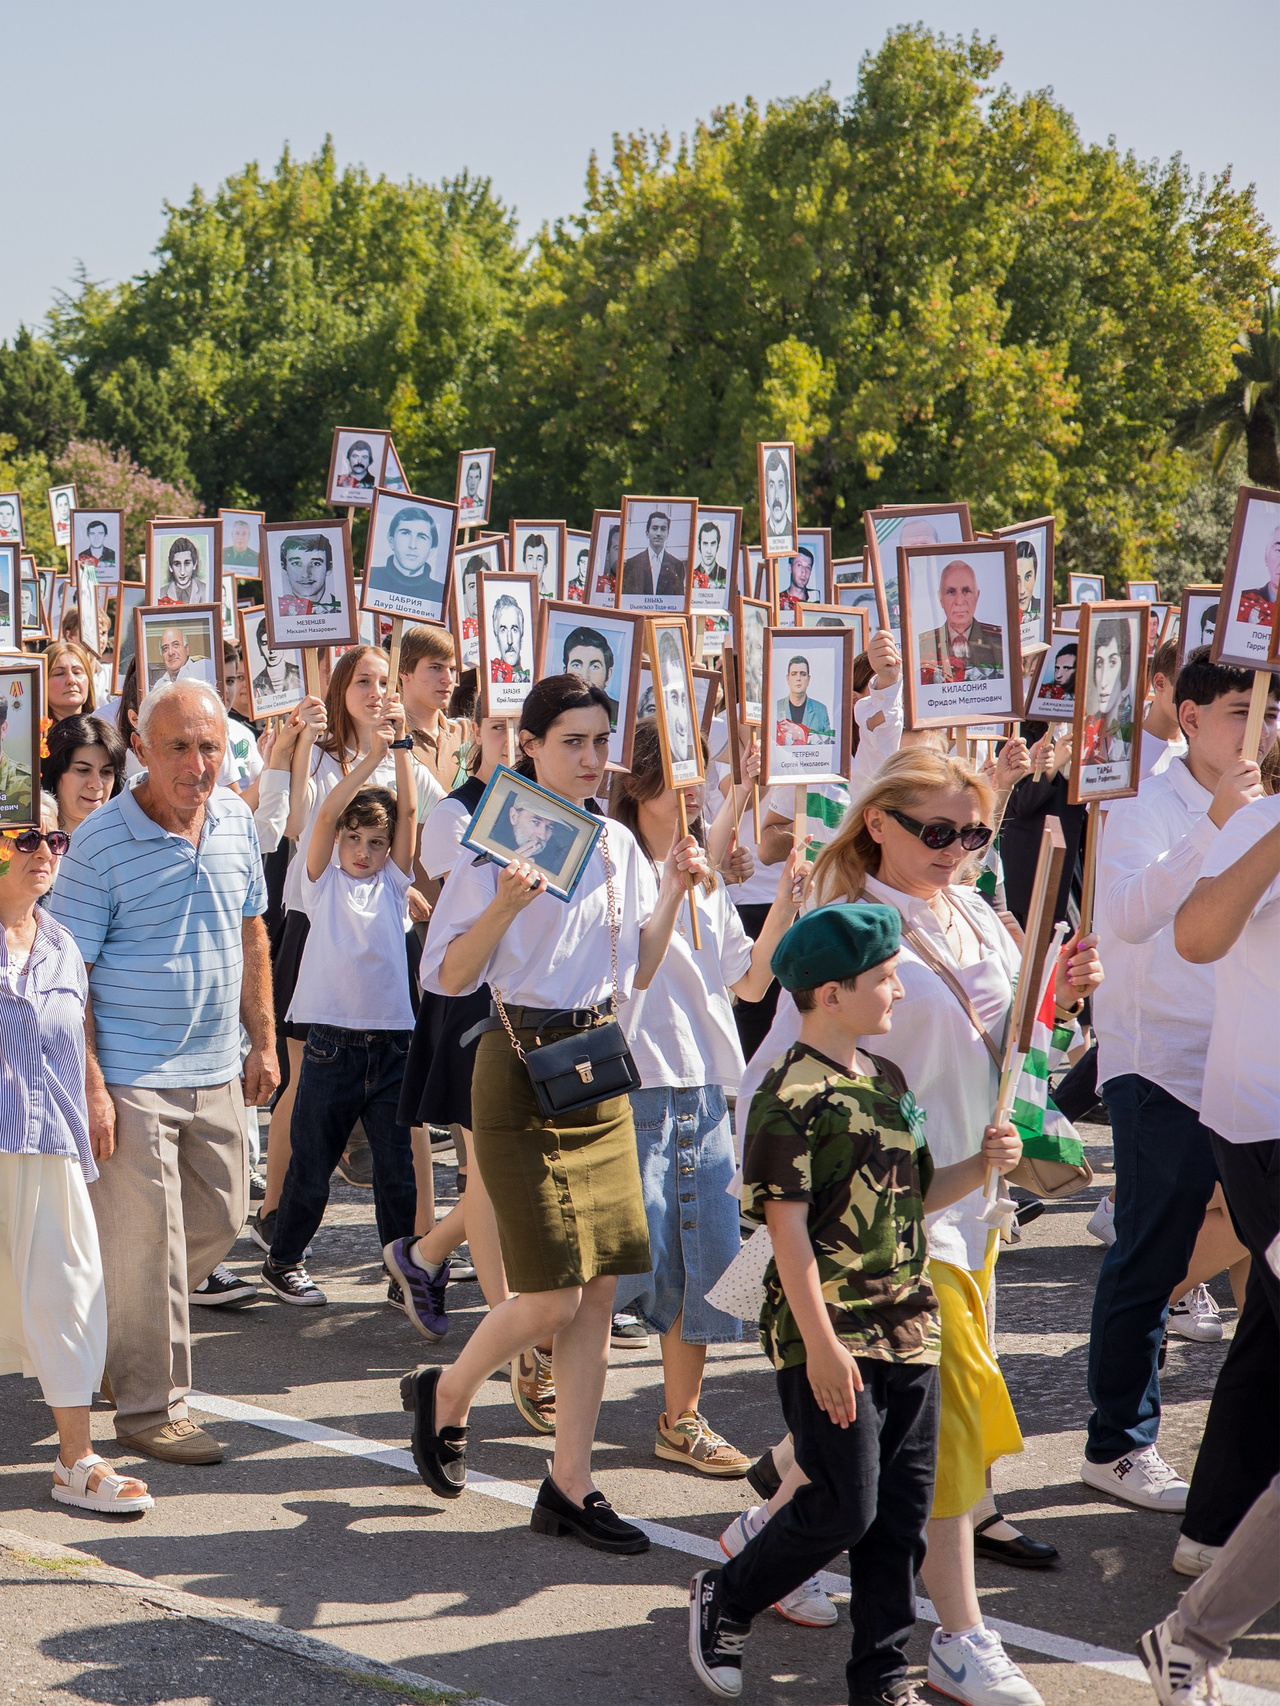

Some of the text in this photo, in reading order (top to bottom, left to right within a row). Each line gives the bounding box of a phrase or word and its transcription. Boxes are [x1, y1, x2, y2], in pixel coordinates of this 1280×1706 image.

[389, 594, 423, 607] ЦАБРИЯ
[374, 599, 436, 618] Даур Шотаевич
[296, 618, 326, 626] МЕЗЕНЦЕВ
[1252, 631, 1271, 641] ПОНТ
[1246, 641, 1266, 651] Гарри
[941, 683, 988, 693] КИЛАСОНИЯ
[928, 695, 1003, 708] Фридон Мелтонович
[1096, 766, 1113, 774] ТАРБА
